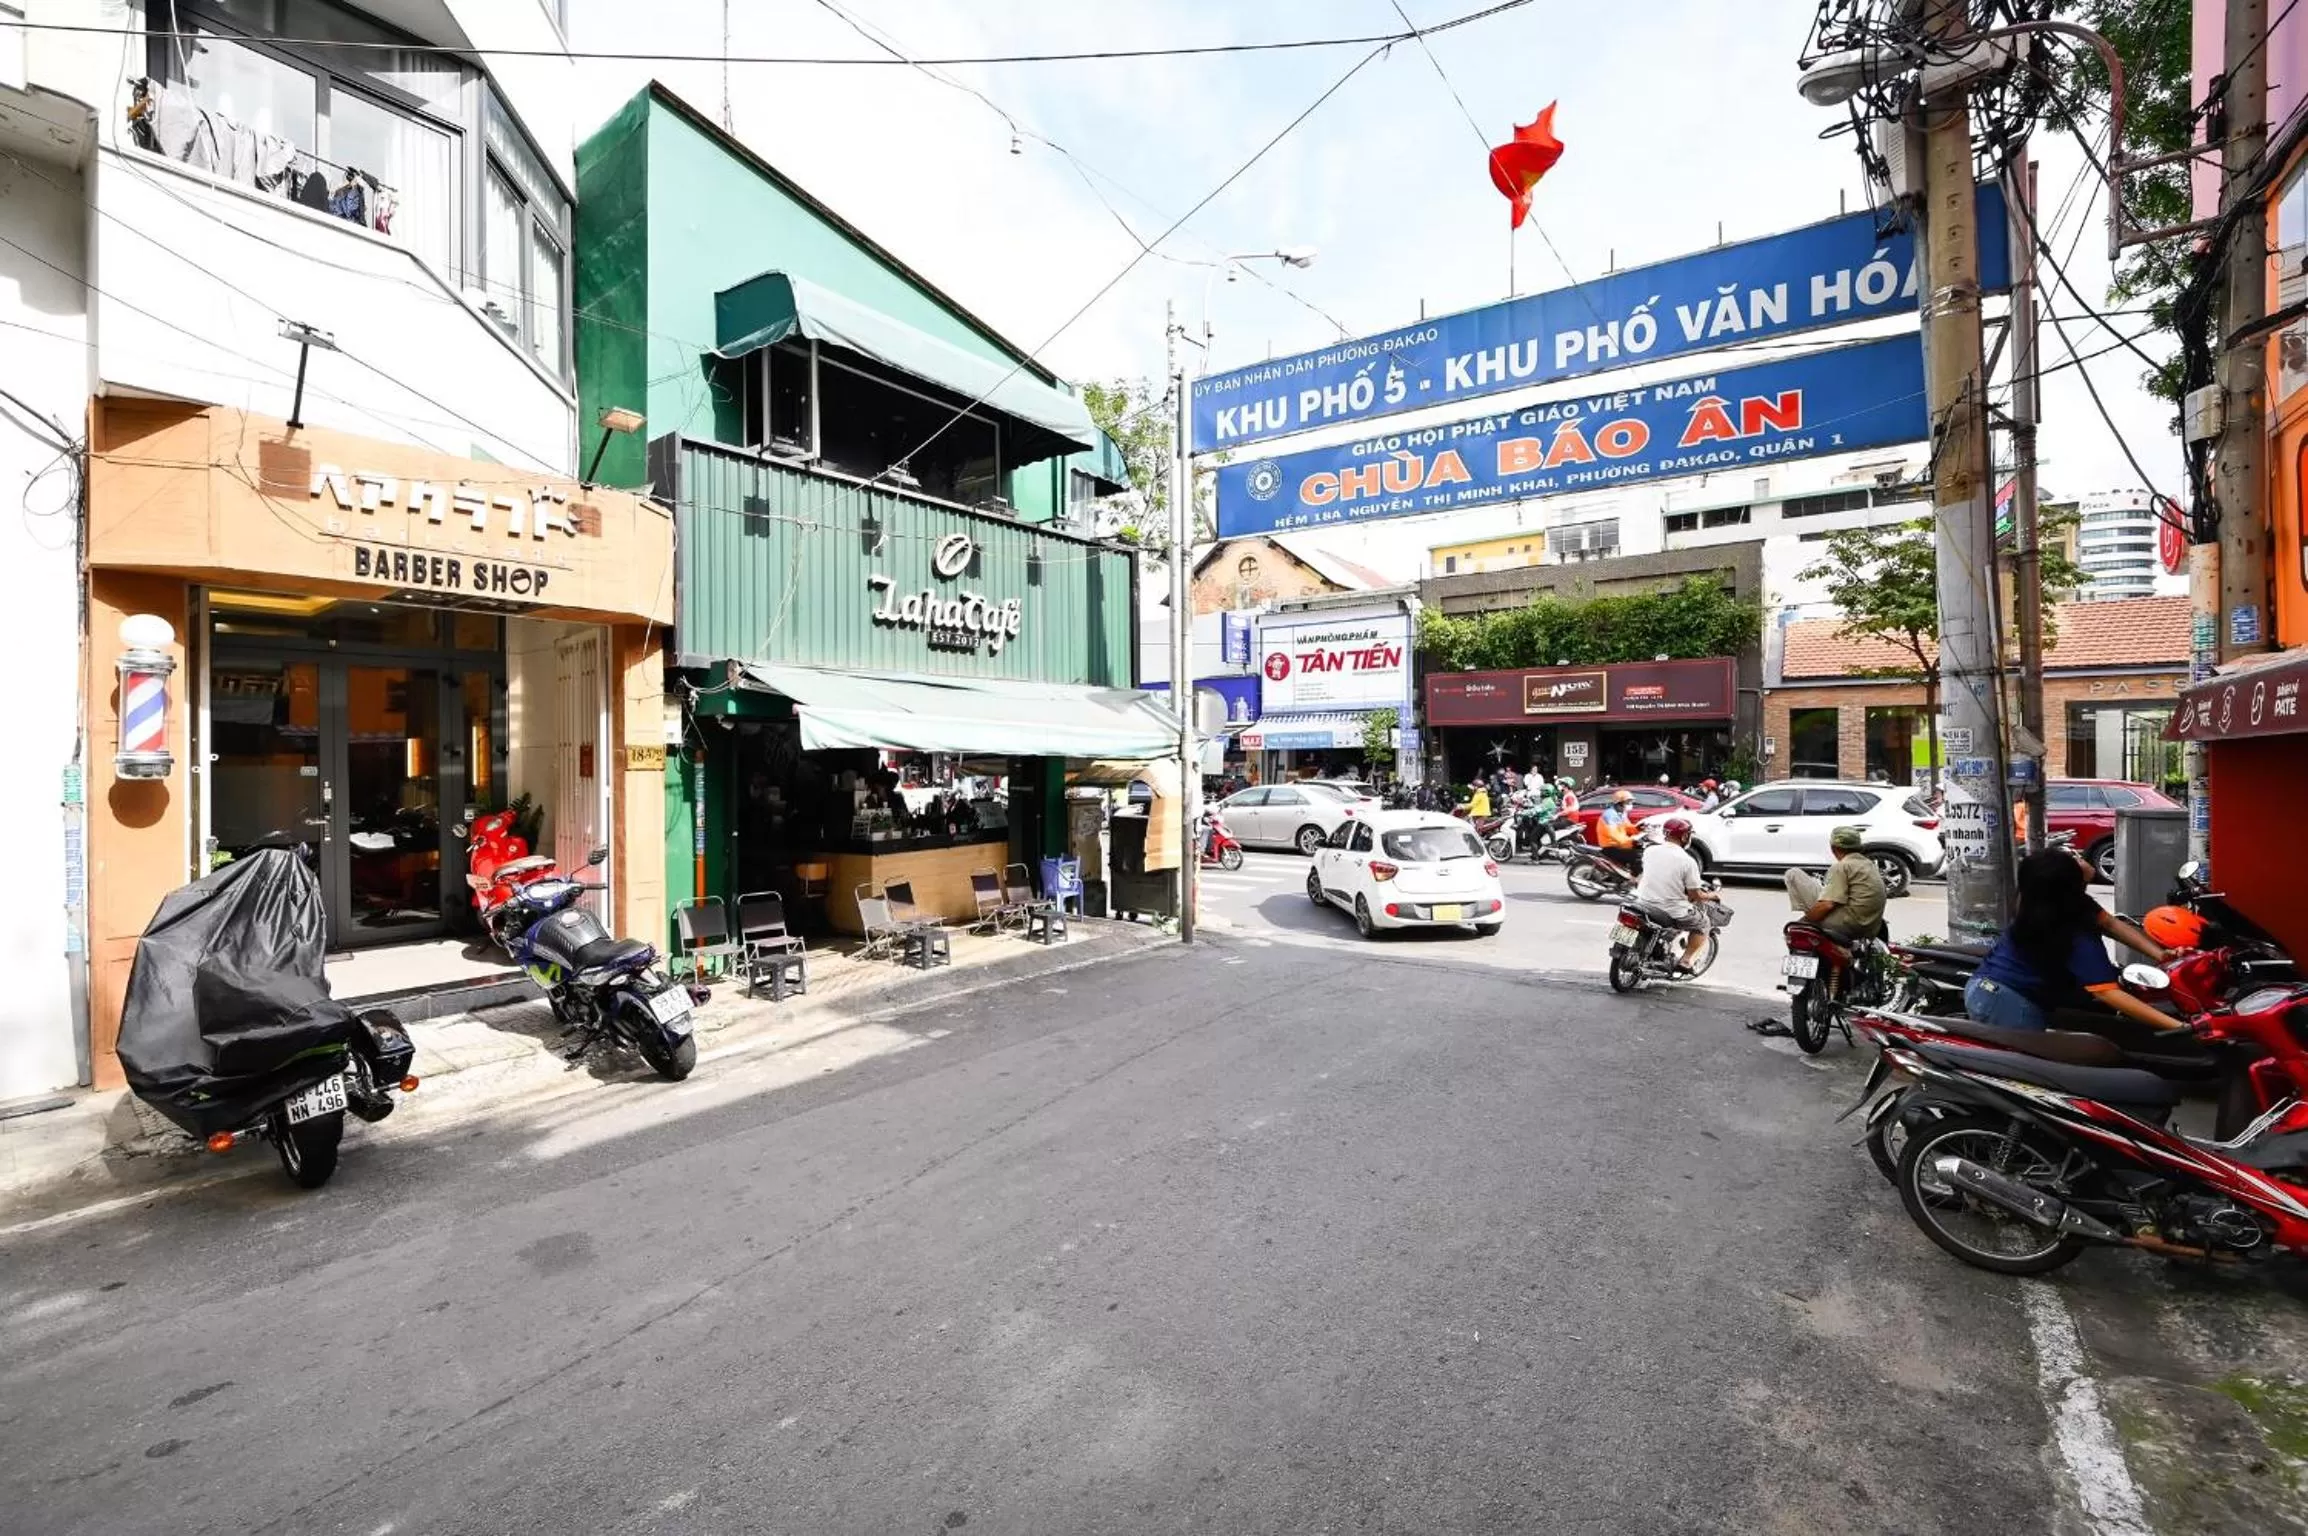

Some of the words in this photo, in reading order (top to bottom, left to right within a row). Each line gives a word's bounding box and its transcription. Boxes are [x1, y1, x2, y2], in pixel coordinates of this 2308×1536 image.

[1215, 378, 1240, 393] BAN
[1245, 367, 1281, 385] NHÂN
[1286, 359, 1315, 377] DÂN
[1318, 342, 1378, 368] PHƯỜNG
[1381, 328, 1437, 351] ĐAKAO
[1216, 396, 1287, 440] KHU
[1300, 361, 1376, 422] PHỐ
[1384, 367, 1406, 404] 5
[1445, 338, 1538, 392] KHU
[1555, 295, 1660, 369] PHỐ
[1675, 282, 1788, 342] VĂN
[1300, 449, 1472, 506] CHÙA
[1677, 394, 1803, 448] ÂN
[1352, 438, 1400, 457] GIÁO
[1407, 431, 1444, 452] HỘI
[1452, 415, 1511, 437] PHẬT
[1520, 403, 1579, 426] GIÁO
[1587, 390, 1647, 412] VIỆT
[1655, 377, 1717, 401] NAM
[1349, 496, 1414, 517] NGUYỄN
[1424, 493, 1452, 506] THỊ
[1457, 485, 1503, 501] MINH
[1509, 477, 1559, 494] KHAI,
[1567, 462, 1650, 484] PHƯỜNG
[1749, 437, 1815, 458] QUẬN
[1831, 433, 1844, 446] 1
[354, 545, 461, 589] BARBER
[473, 561, 549, 597] SHOP
[1296, 647, 1345, 673] TÂN
[1347, 641, 1402, 670] TIẾN
